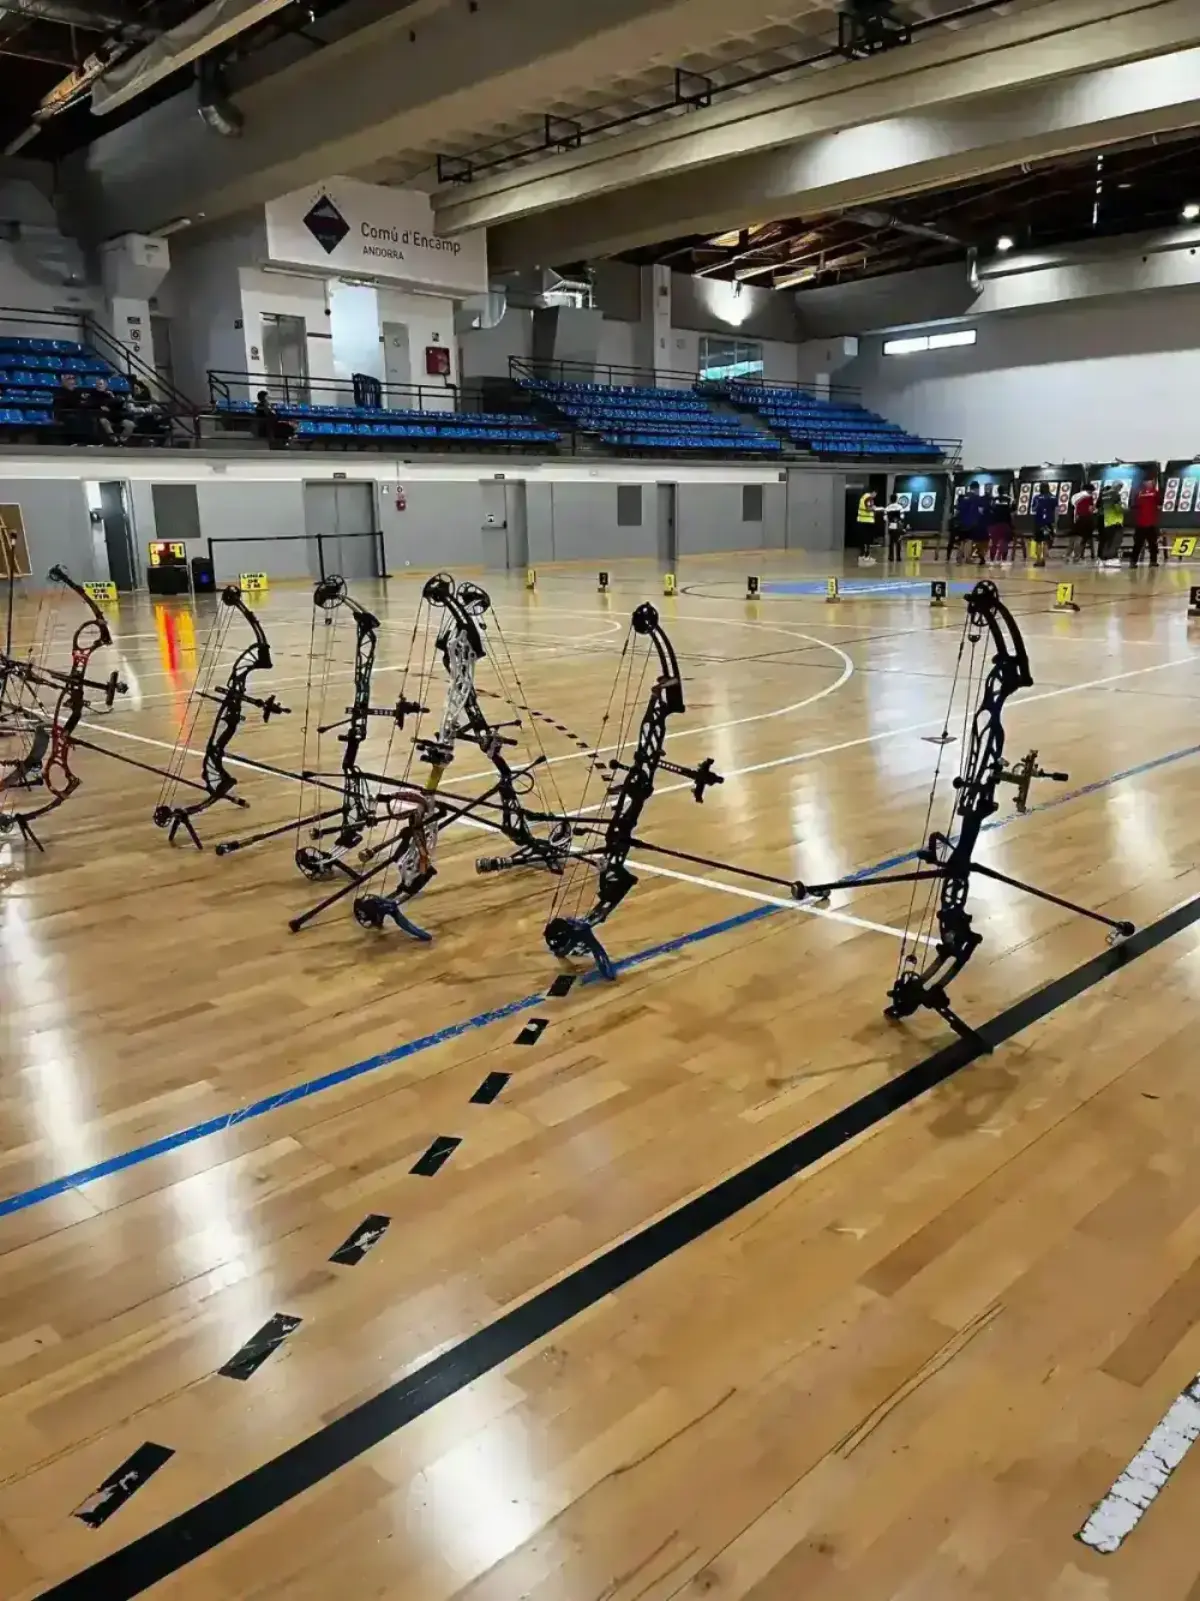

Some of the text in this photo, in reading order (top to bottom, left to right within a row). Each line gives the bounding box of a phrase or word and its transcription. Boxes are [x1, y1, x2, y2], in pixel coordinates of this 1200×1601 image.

[361, 222, 398, 242] Comú
[402, 230, 461, 256] d'Encamp
[362, 245, 405, 260] ANDORRA
[911, 542, 918, 556] 1
[1178, 539, 1191, 554] 5
[935, 583, 942, 595] 6
[1062, 586, 1068, 598] 7
